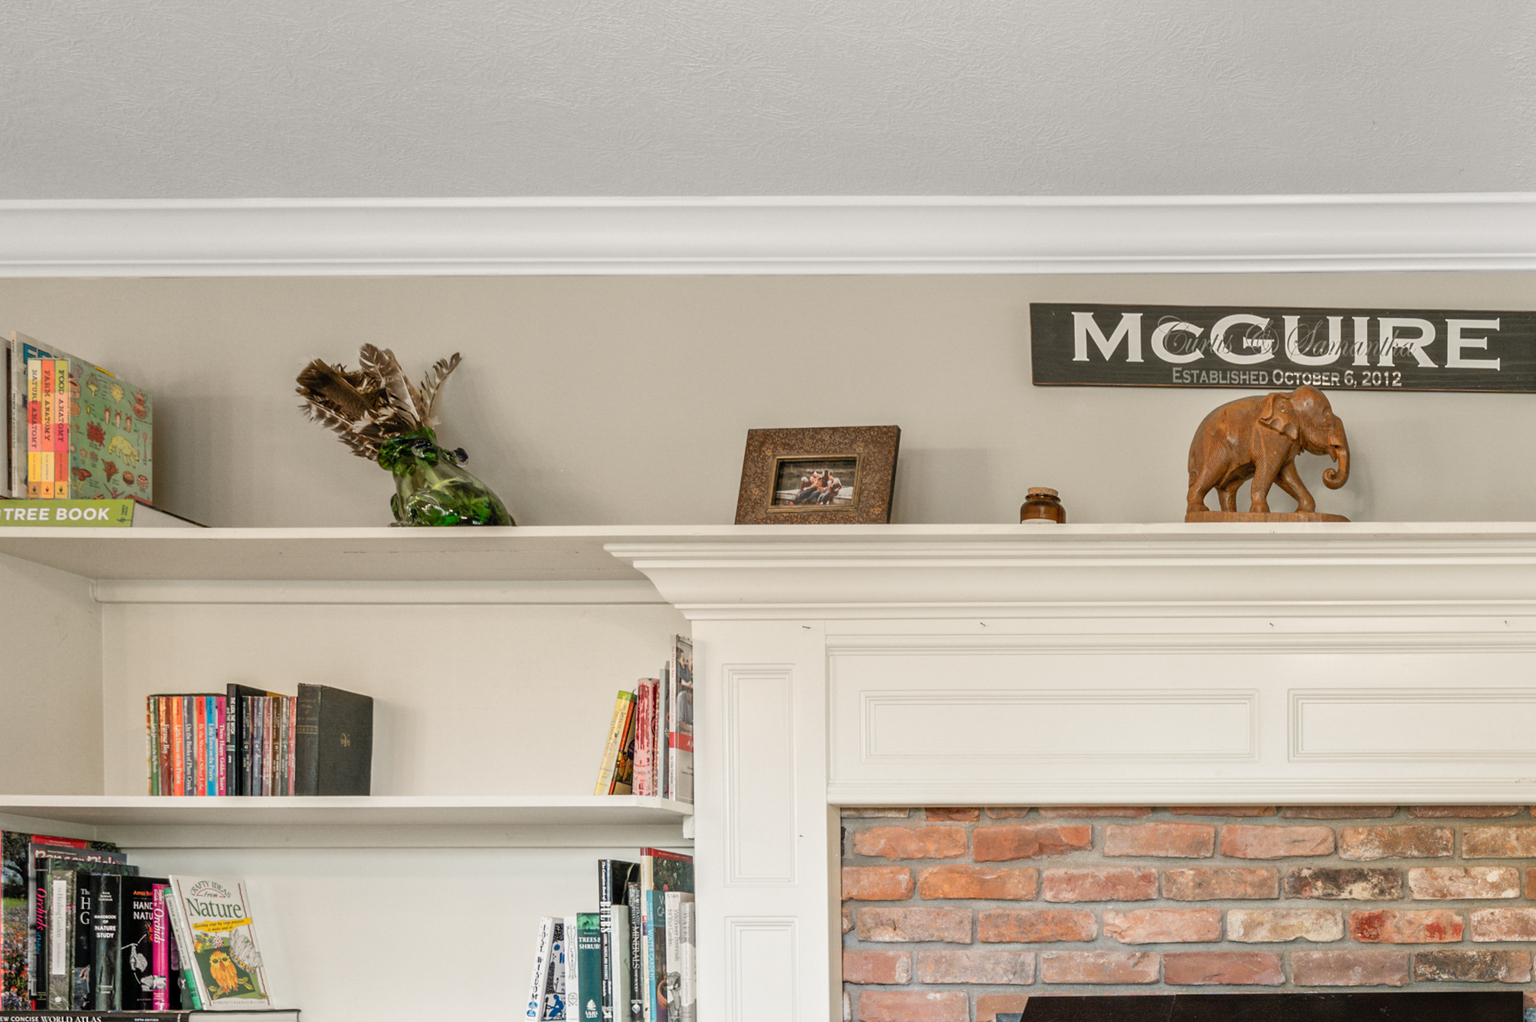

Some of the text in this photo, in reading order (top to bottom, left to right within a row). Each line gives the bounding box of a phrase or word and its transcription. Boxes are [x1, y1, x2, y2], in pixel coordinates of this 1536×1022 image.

[1286, 325, 1417, 357] Samantha
[1344, 370, 1357, 387] 6,
[1361, 371, 1402, 387] 2012
[3, 508, 111, 521] TREE BOOK
[161, 744, 169, 755] Boy
[190, 880, 231, 898] CRAFTY IDEAS
[36, 888, 48, 931] Orchids
[54, 893, 63, 916] Healing
[185, 898, 243, 919] Nature
[153, 908, 165, 944] Orchids
[600, 901, 612, 933] BULBS
[631, 926, 640, 969] MINERALS
[40, 1015, 72, 1022] WORLD
[75, 1015, 102, 1022] ATLAS
